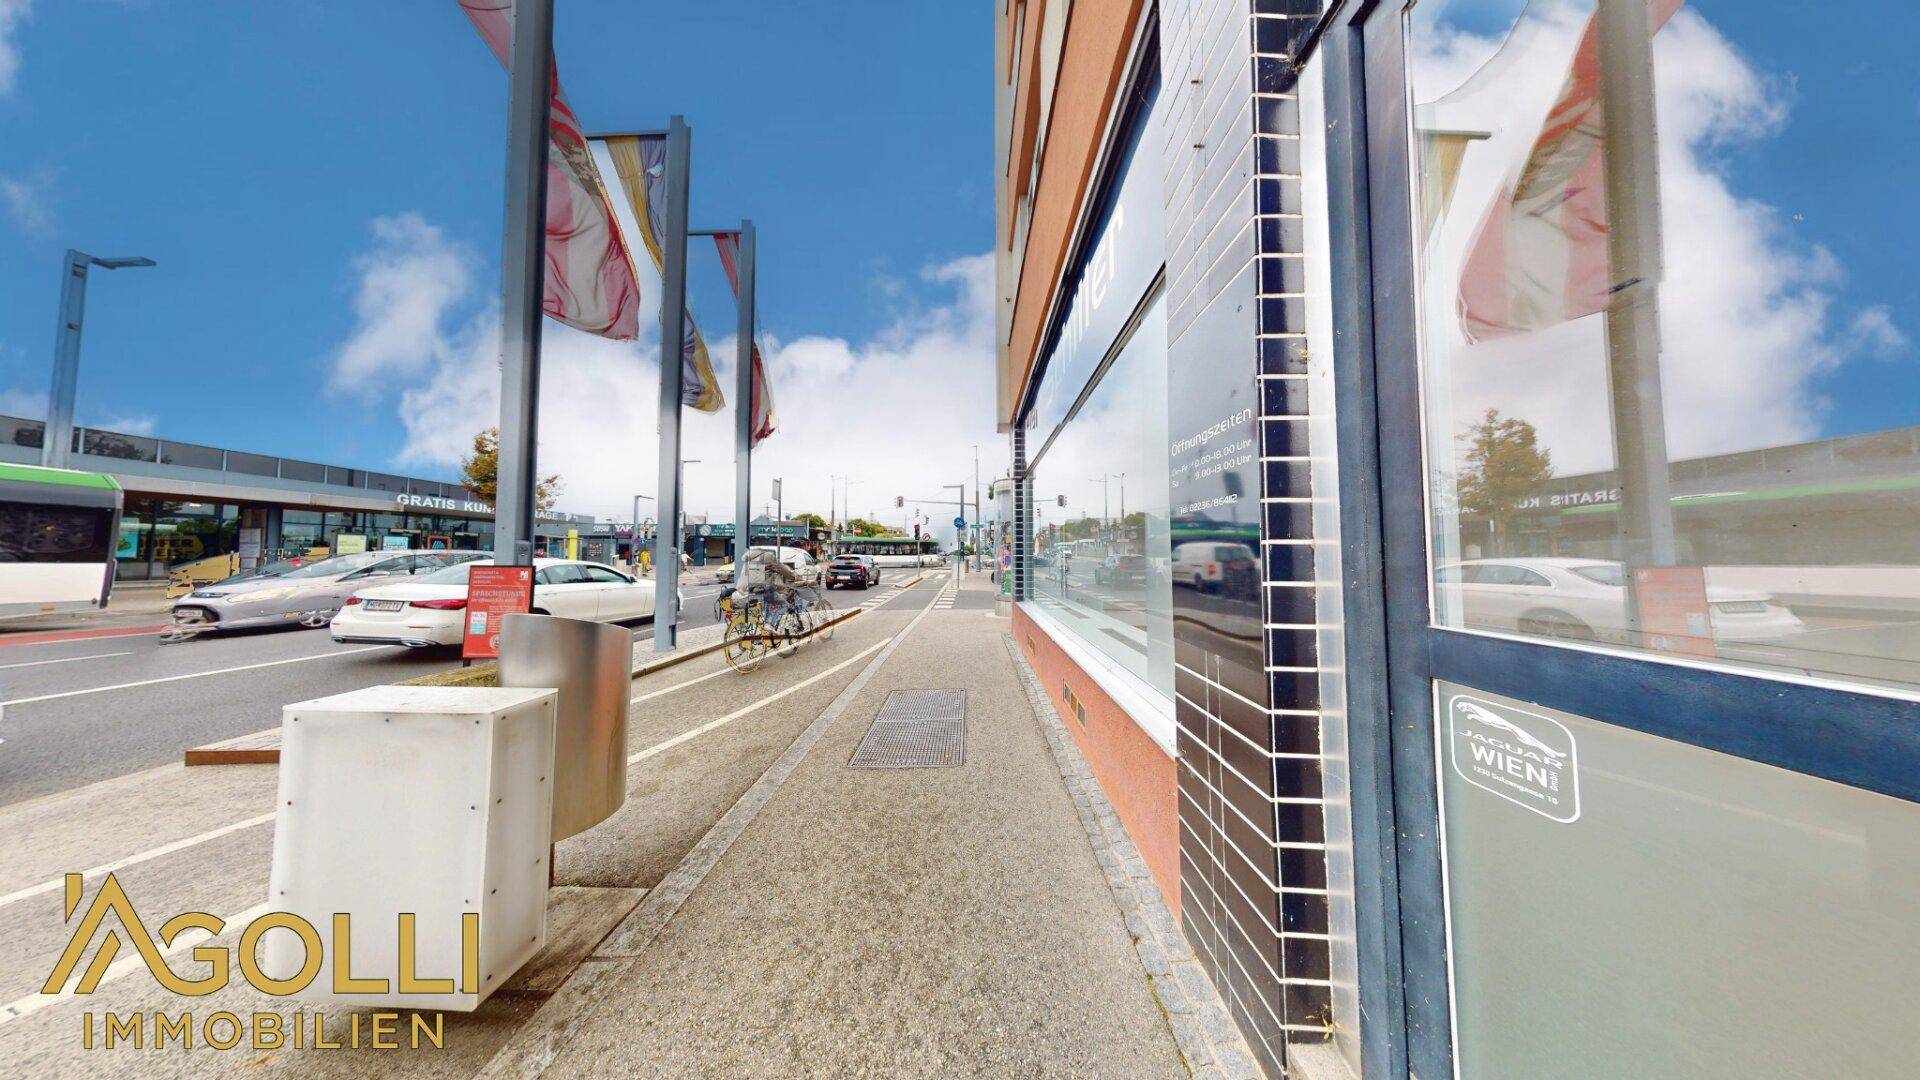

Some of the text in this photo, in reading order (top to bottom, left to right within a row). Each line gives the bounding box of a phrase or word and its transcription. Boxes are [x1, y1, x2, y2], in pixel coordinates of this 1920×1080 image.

[1171, 408, 1252, 457] Öffnungszeiten
[1236, 439, 1252, 451] Uhr
[1236, 454, 1252, 466] Uhr
[396, 494, 456, 510] GRATIS
[1456, 729, 1563, 769] JAGUAR
[1470, 742, 1548, 788] WIEN
